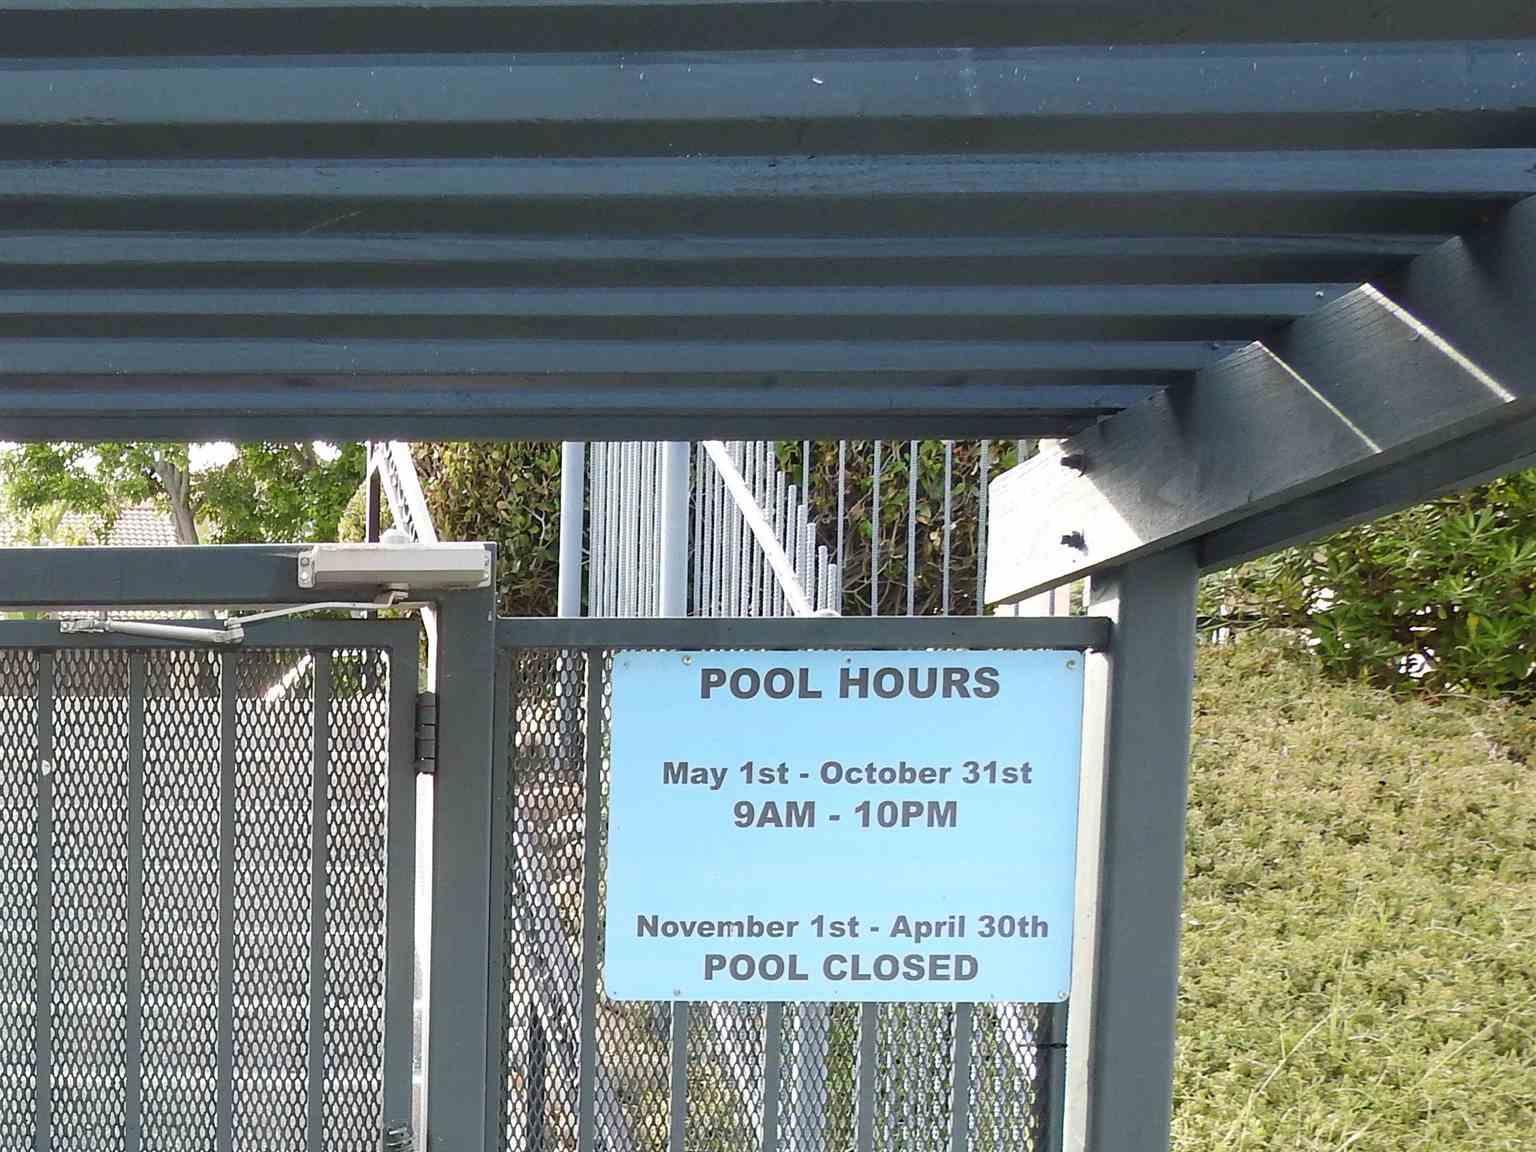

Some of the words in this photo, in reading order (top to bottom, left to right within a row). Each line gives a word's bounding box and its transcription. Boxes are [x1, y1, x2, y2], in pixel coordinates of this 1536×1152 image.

[699, 667, 822, 699] POOL
[839, 667, 1001, 698] HOURS
[663, 761, 728, 790] May
[740, 761, 788, 784] 1st
[820, 760, 952, 784] October
[961, 760, 1032, 784] 31st
[733, 800, 816, 828] 9AM
[854, 800, 957, 828] 10PM
[636, 914, 799, 937] November
[810, 915, 859, 937] 1st
[890, 914, 965, 943] April
[977, 914, 1049, 937] 30th
[703, 954, 809, 981] POOL
[822, 953, 979, 981] CLOSED
